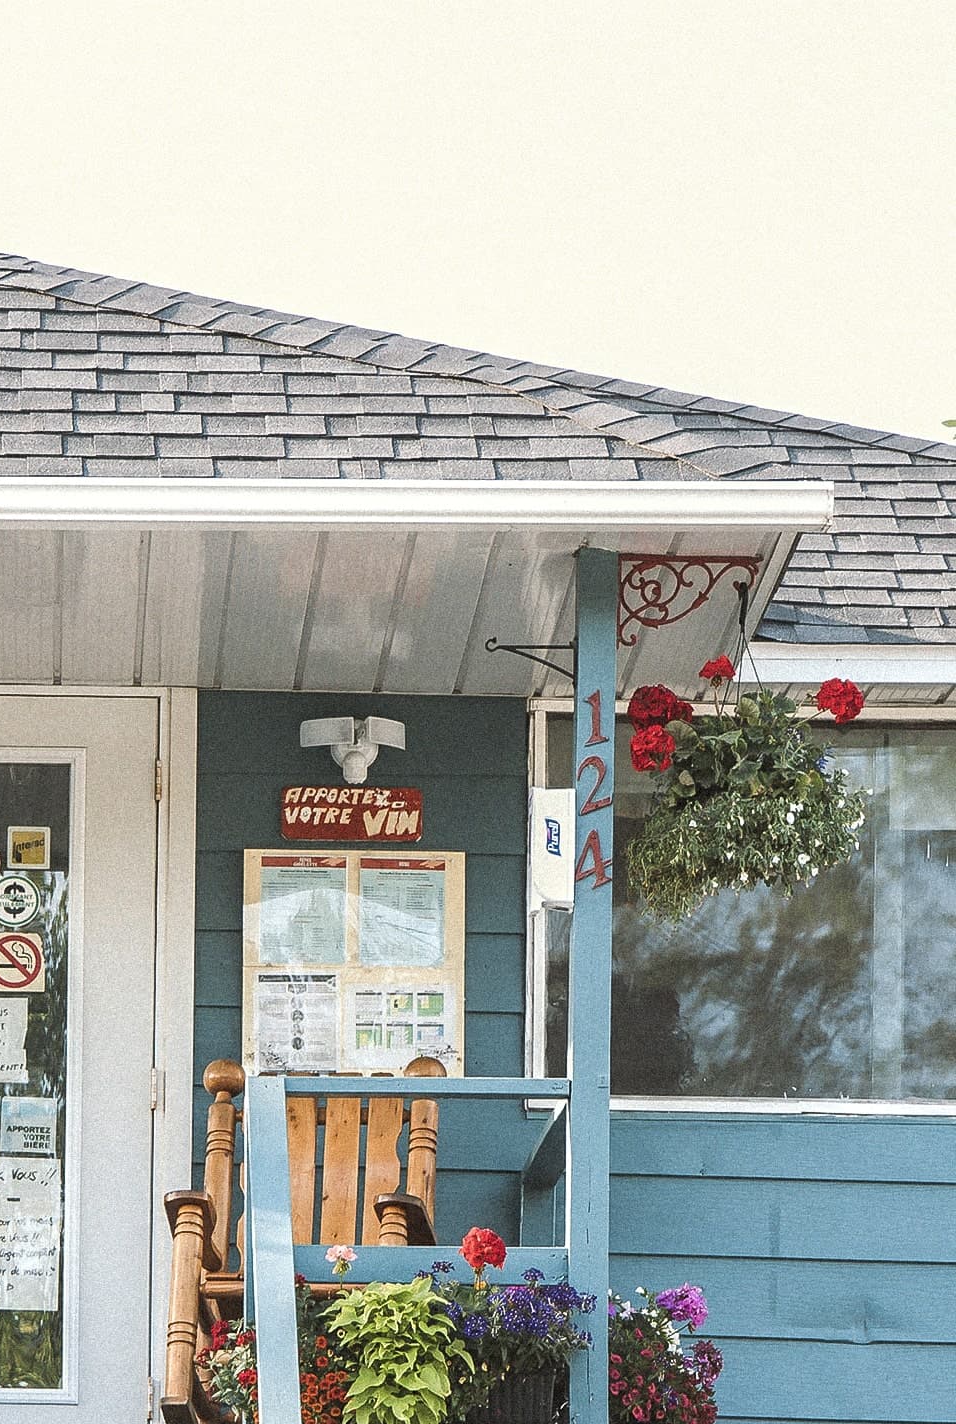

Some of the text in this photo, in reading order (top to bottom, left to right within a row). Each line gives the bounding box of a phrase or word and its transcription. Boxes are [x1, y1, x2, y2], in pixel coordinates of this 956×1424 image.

[284, 787, 392, 807] APPORTEZ
[284, 806, 420, 837] VOTRE VIN
[6, 1125, 51, 1134] APPORTEZ
[10, 1265, 20, 1276] de
